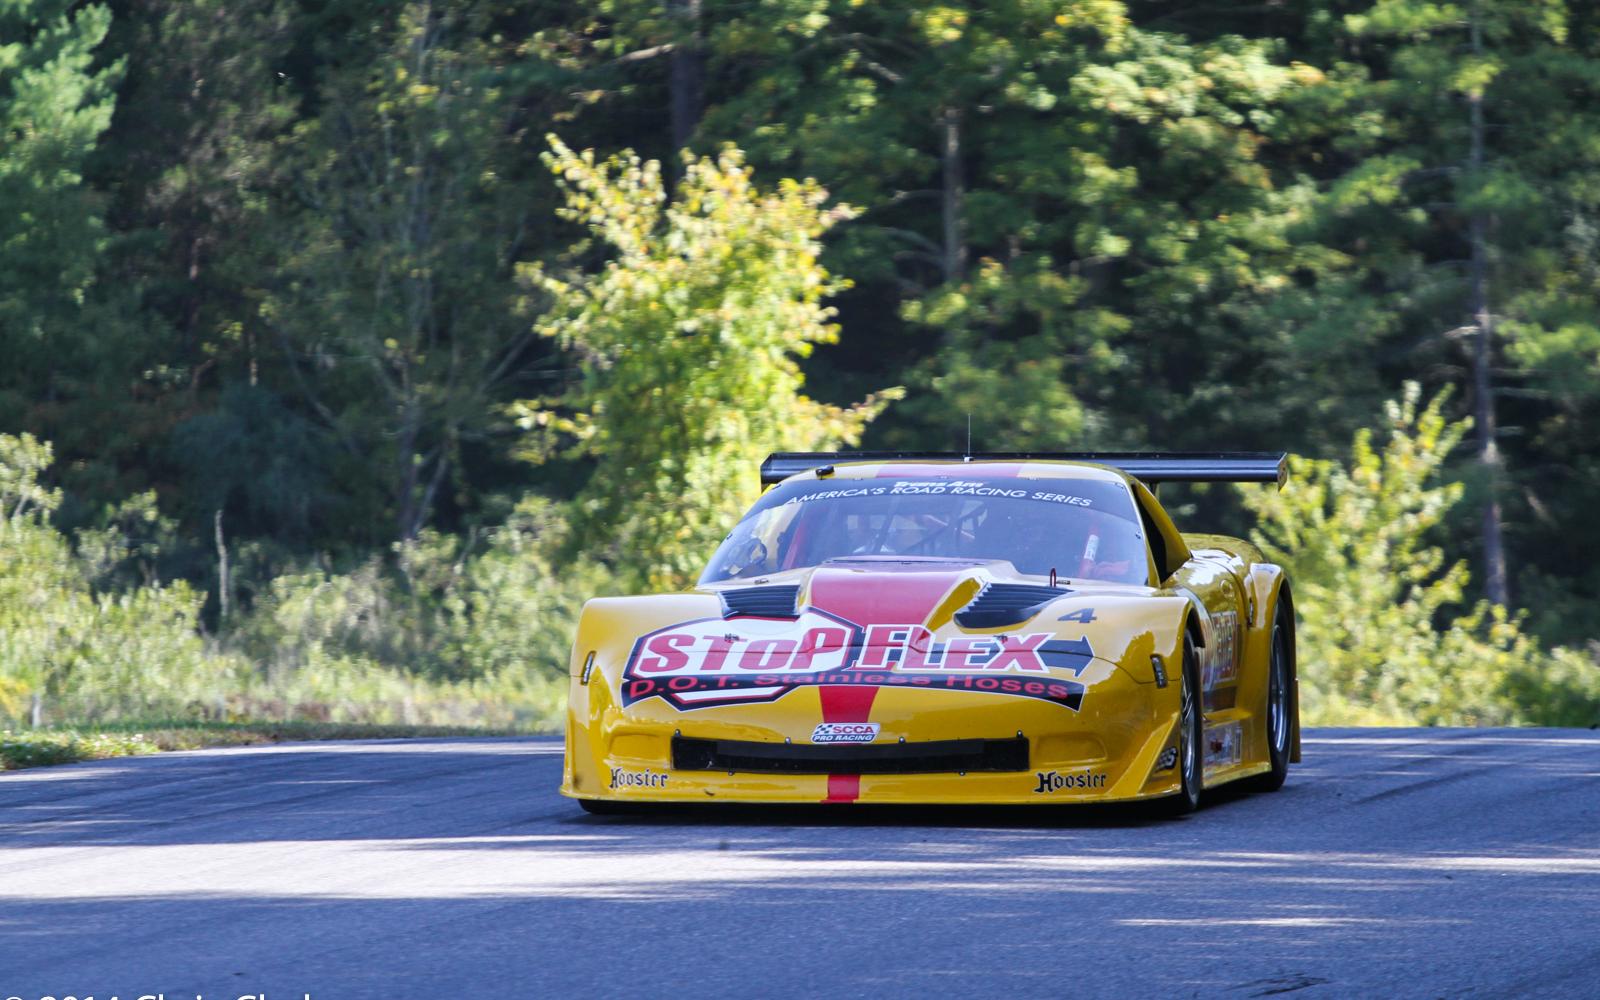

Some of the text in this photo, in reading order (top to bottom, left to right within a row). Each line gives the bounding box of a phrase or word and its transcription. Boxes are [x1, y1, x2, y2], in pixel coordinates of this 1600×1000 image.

[785, 486, 1093, 507] AMERICA'S ROAD RACING SERIES
[1056, 607, 1098, 624] 4
[856, 624, 1056, 673] FLEX
[629, 673, 1069, 699] D.O.T. Stainless Hoses
[813, 734, 874, 742] PRO RACING
[832, 725, 875, 734] SCCA
[608, 767, 669, 789] Hoosier
[1033, 768, 1107, 793] Hoosier
